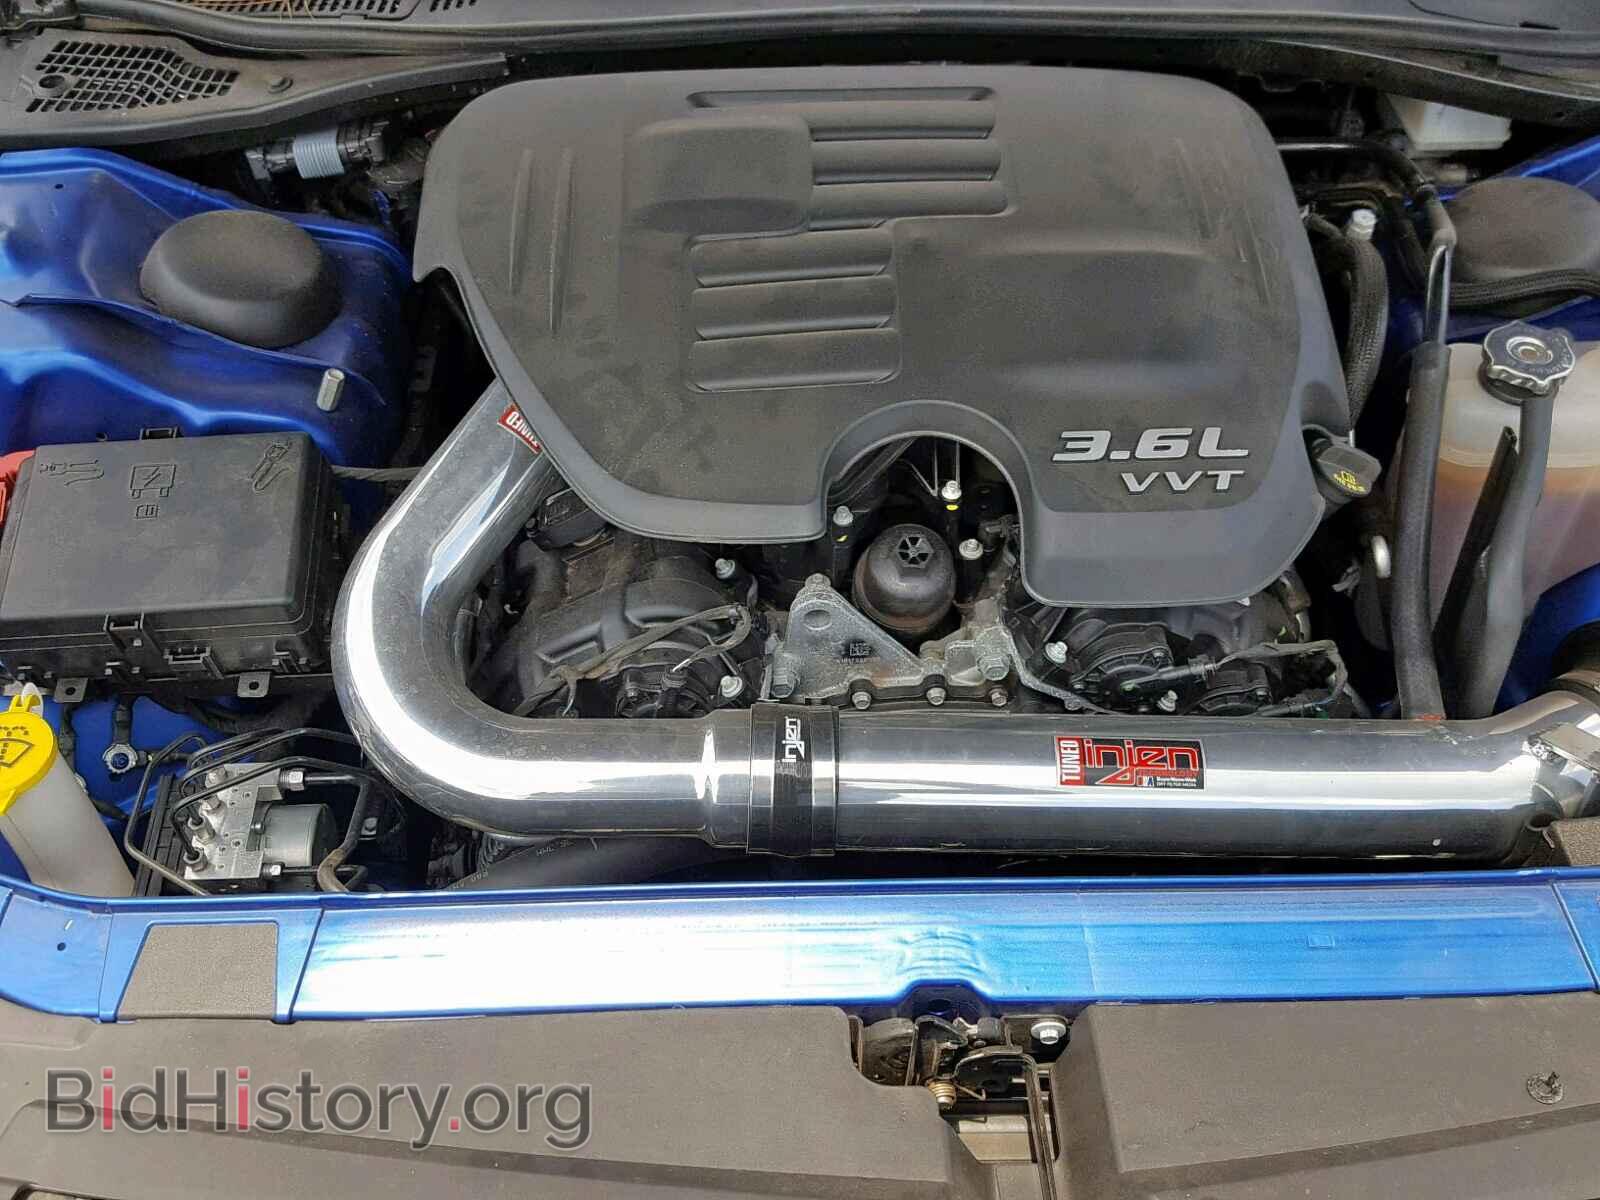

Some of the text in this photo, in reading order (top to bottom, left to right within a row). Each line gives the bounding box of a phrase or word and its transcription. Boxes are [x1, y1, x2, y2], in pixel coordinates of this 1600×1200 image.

[1052, 427, 1249, 461] 3.6L
[1120, 470, 1246, 493] VVT
[781, 716, 805, 763] injen
[1060, 740, 1081, 782] TUNED
[1084, 739, 1200, 785] injen
